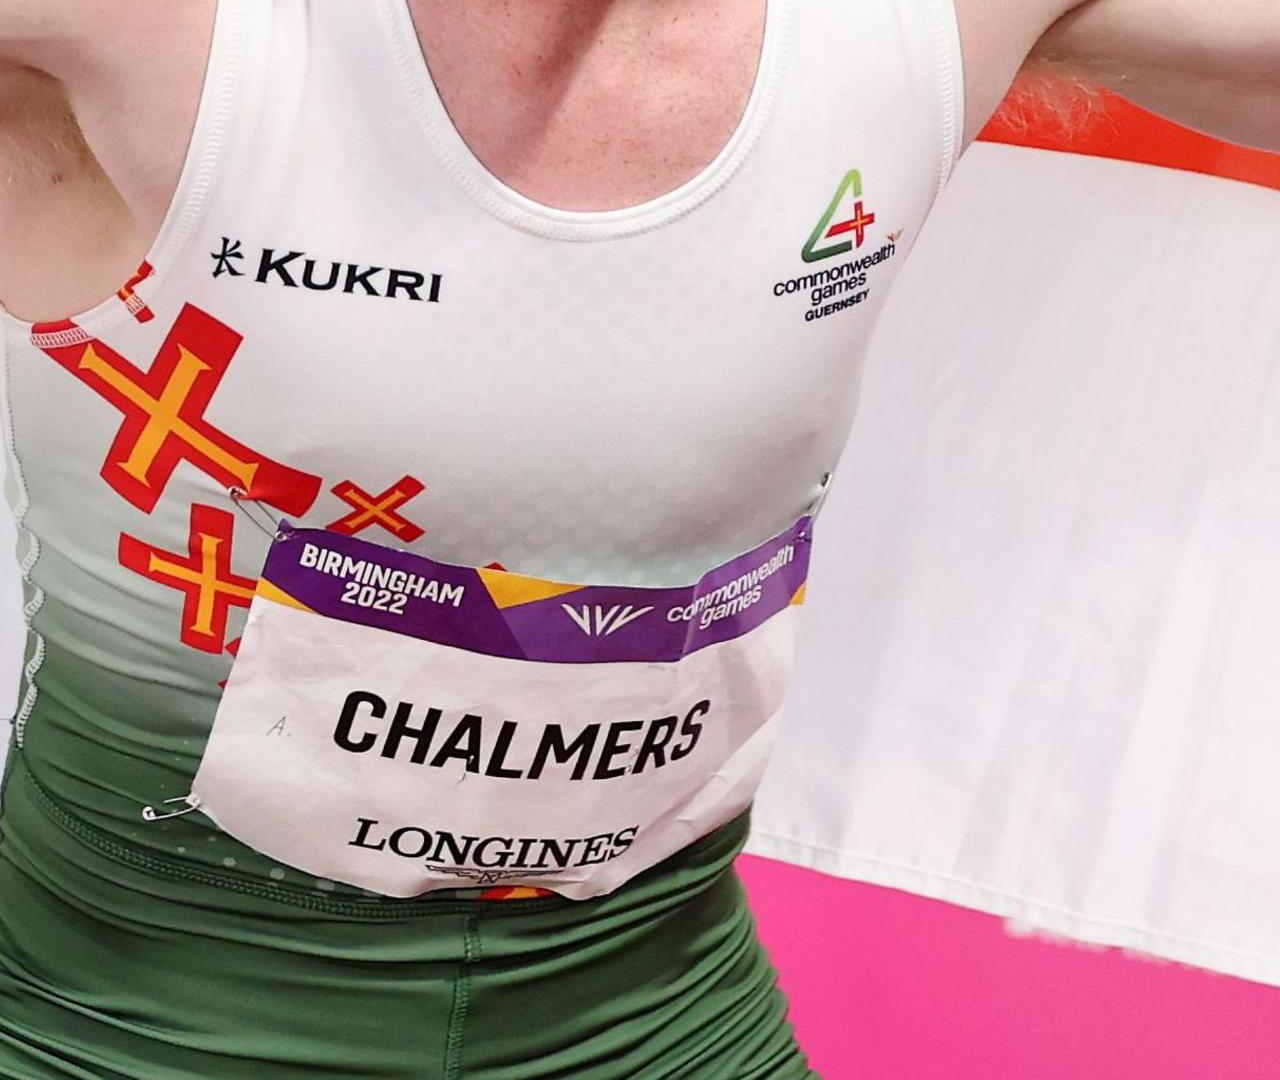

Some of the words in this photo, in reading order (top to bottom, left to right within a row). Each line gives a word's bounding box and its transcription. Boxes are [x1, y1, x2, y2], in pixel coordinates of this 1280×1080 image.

[254, 248, 443, 303] KUKRI
[773, 243, 896, 297] commonwealth
[811, 272, 867, 306] games
[804, 288, 870, 322] GUERNSEY
[299, 543, 465, 607] BIRMINGHAM
[340, 582, 408, 615] 2022
[667, 544, 795, 622] commonwealth
[699, 584, 762, 630] games
[332, 690, 711, 781] CHALMERS
[348, 818, 640, 869] LONGINES
